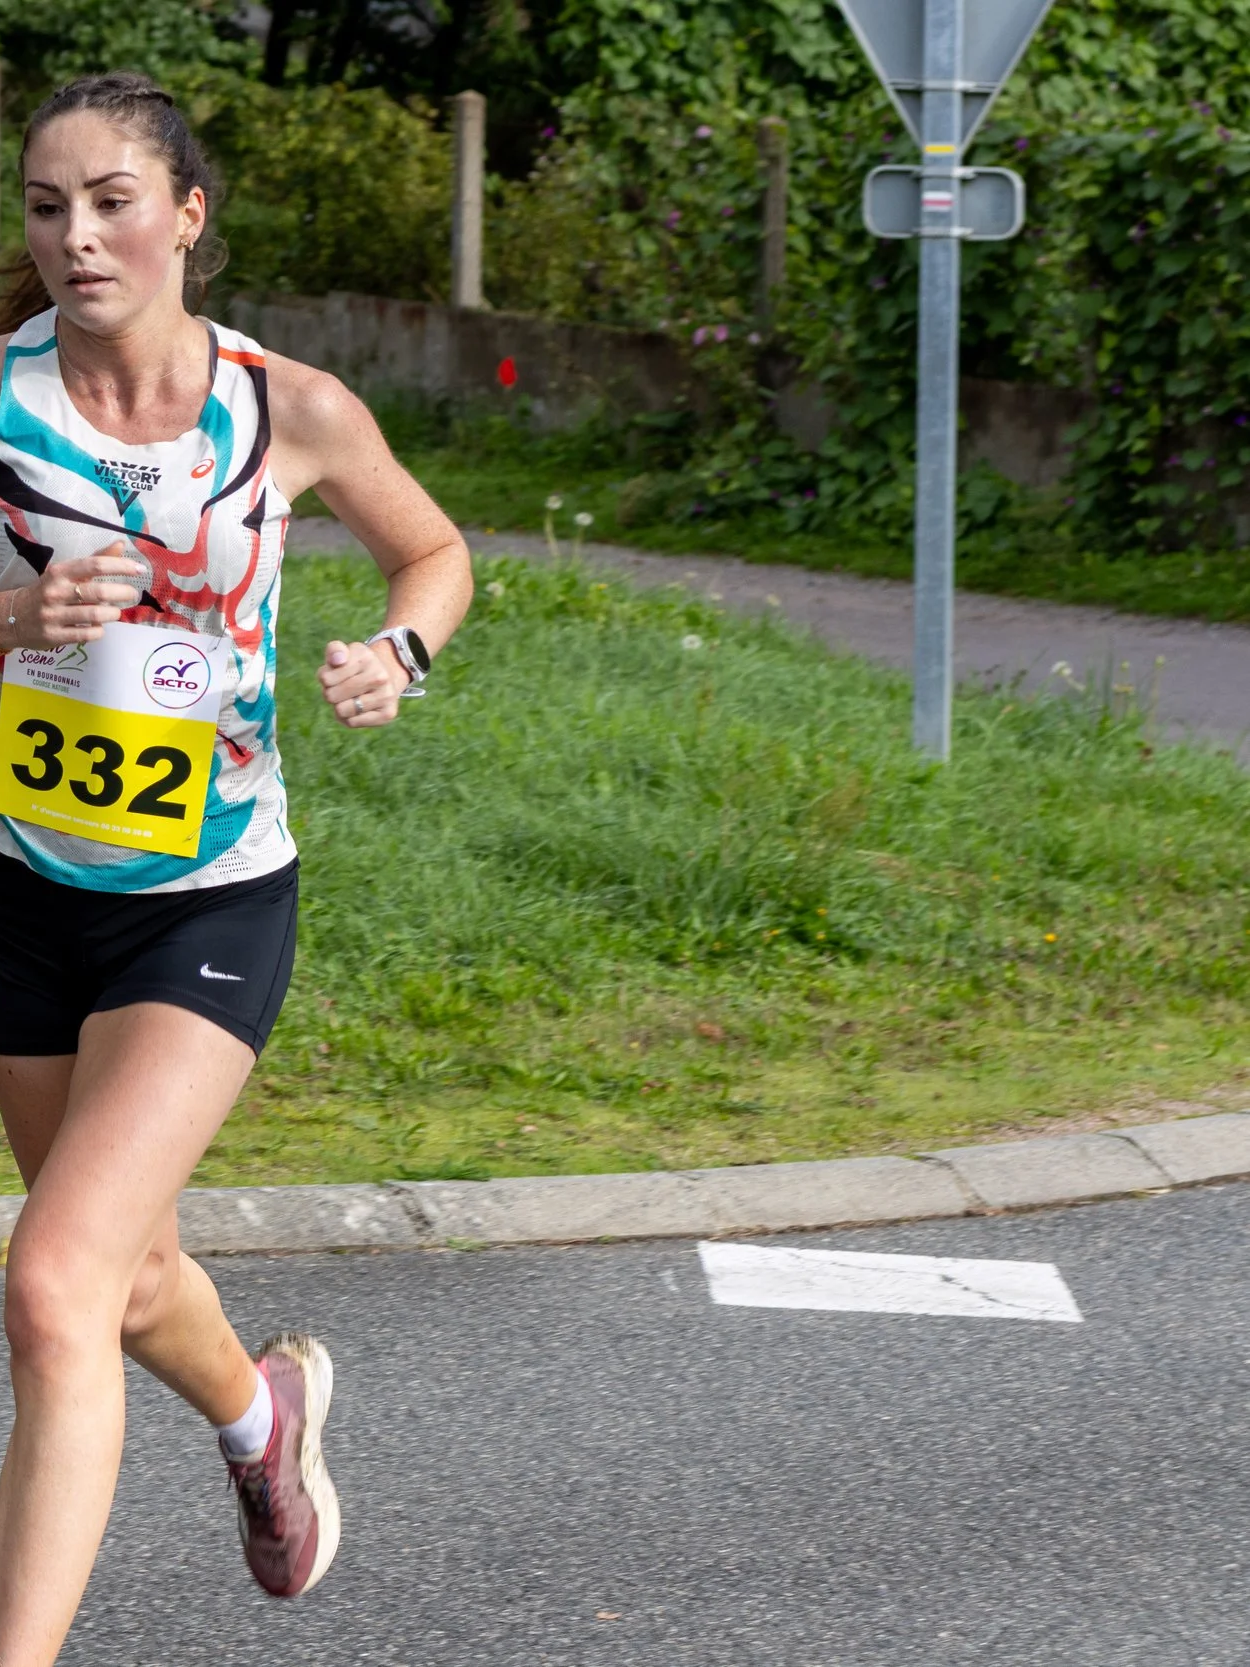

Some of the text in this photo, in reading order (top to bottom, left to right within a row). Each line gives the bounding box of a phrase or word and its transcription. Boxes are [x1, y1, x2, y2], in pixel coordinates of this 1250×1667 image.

[94, 465, 162, 485] VICTORY
[99, 477, 153, 492] TRACK CLUB
[18, 649, 56, 666] Scène
[27, 669, 81, 688] EN BOURBONNAIS
[11, 718, 192, 820] 332
